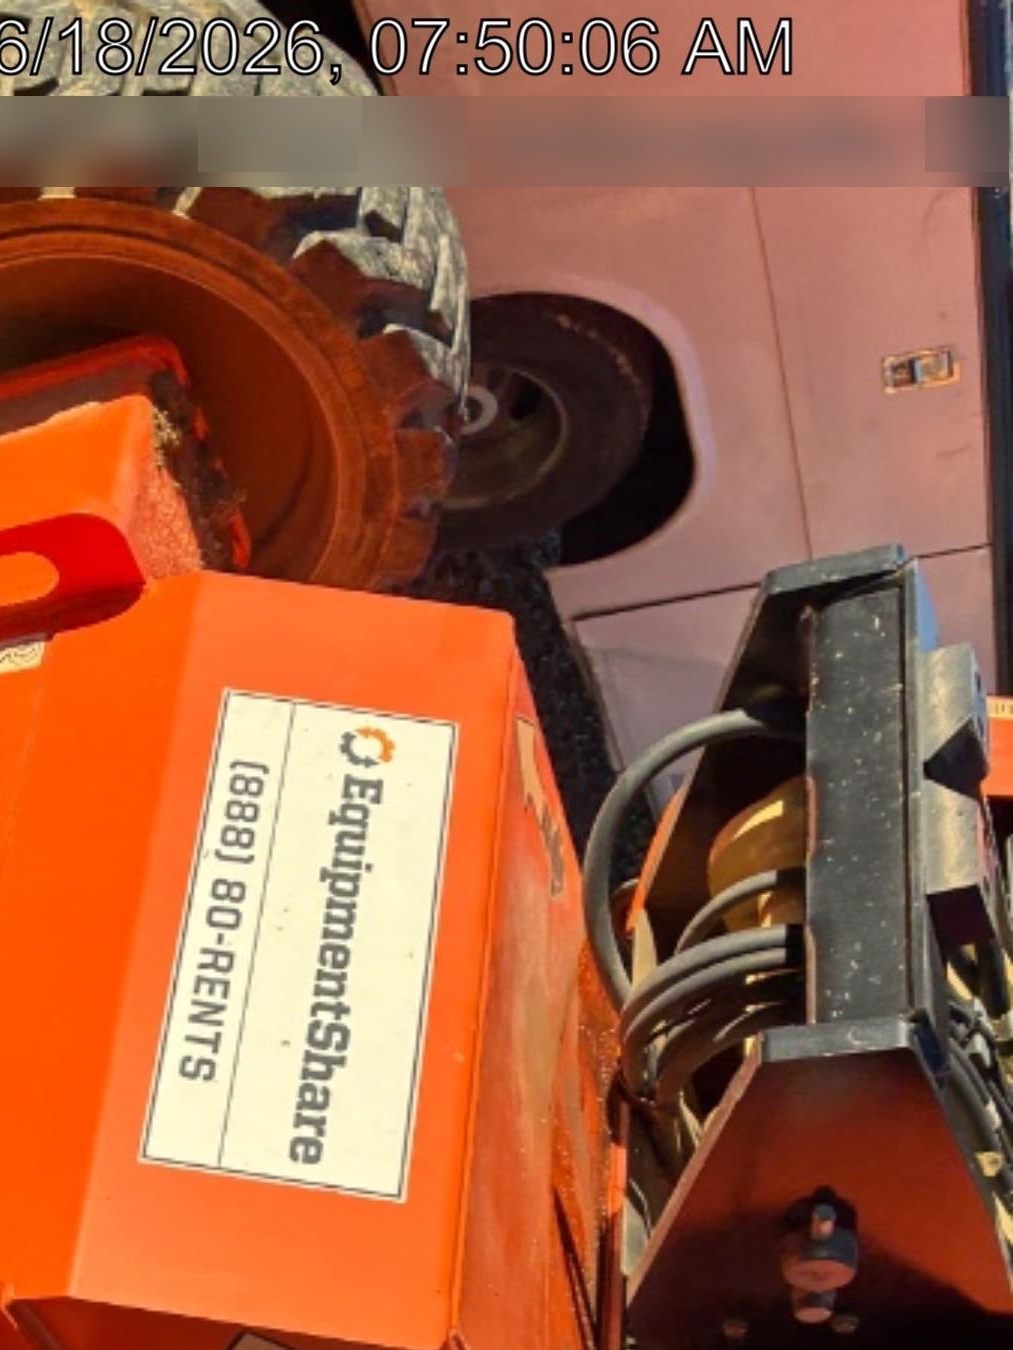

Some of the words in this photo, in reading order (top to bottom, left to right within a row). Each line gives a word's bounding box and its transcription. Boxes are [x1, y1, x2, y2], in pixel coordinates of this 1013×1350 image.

[214, 760, 271, 865] (888)
[179, 878, 247, 1082] 80-RENTS
[289, 774, 384, 1165] EquipmentShare
